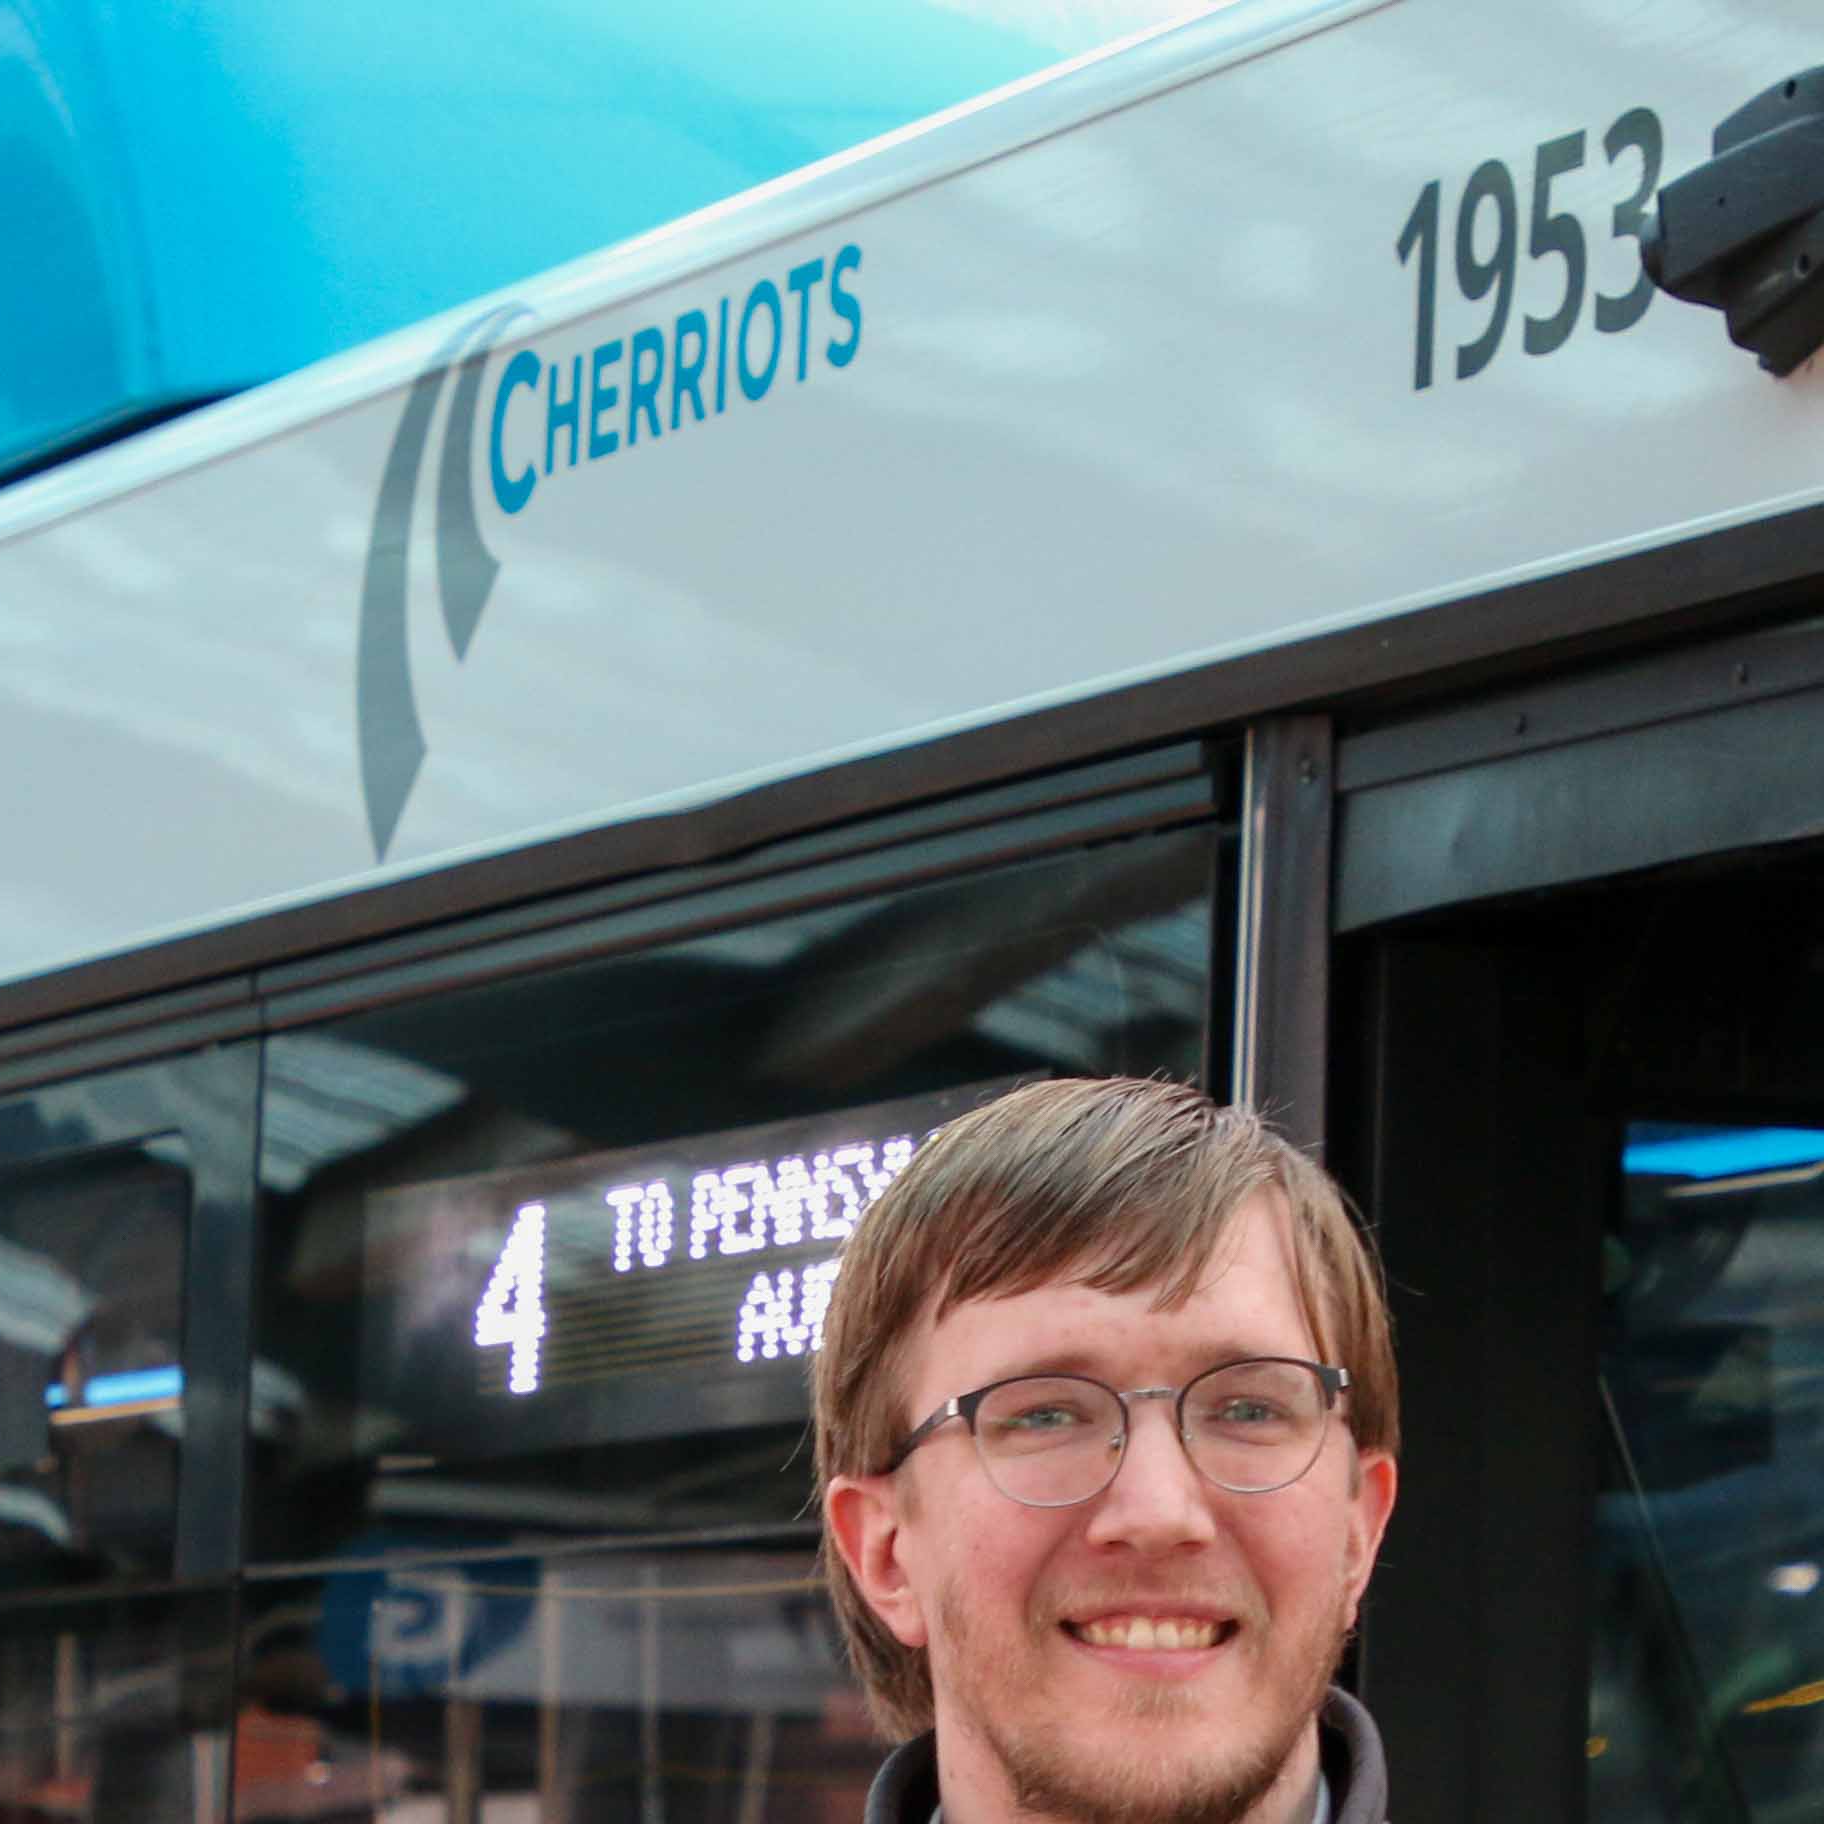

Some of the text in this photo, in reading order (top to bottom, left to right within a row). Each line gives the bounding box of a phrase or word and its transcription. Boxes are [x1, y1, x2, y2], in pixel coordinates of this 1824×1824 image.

[489, 243, 863, 515] CHERRIOTS
[1395, 105, 1664, 392] 1953
[474, 1138, 914, 1396] 4 TO PENNSY
